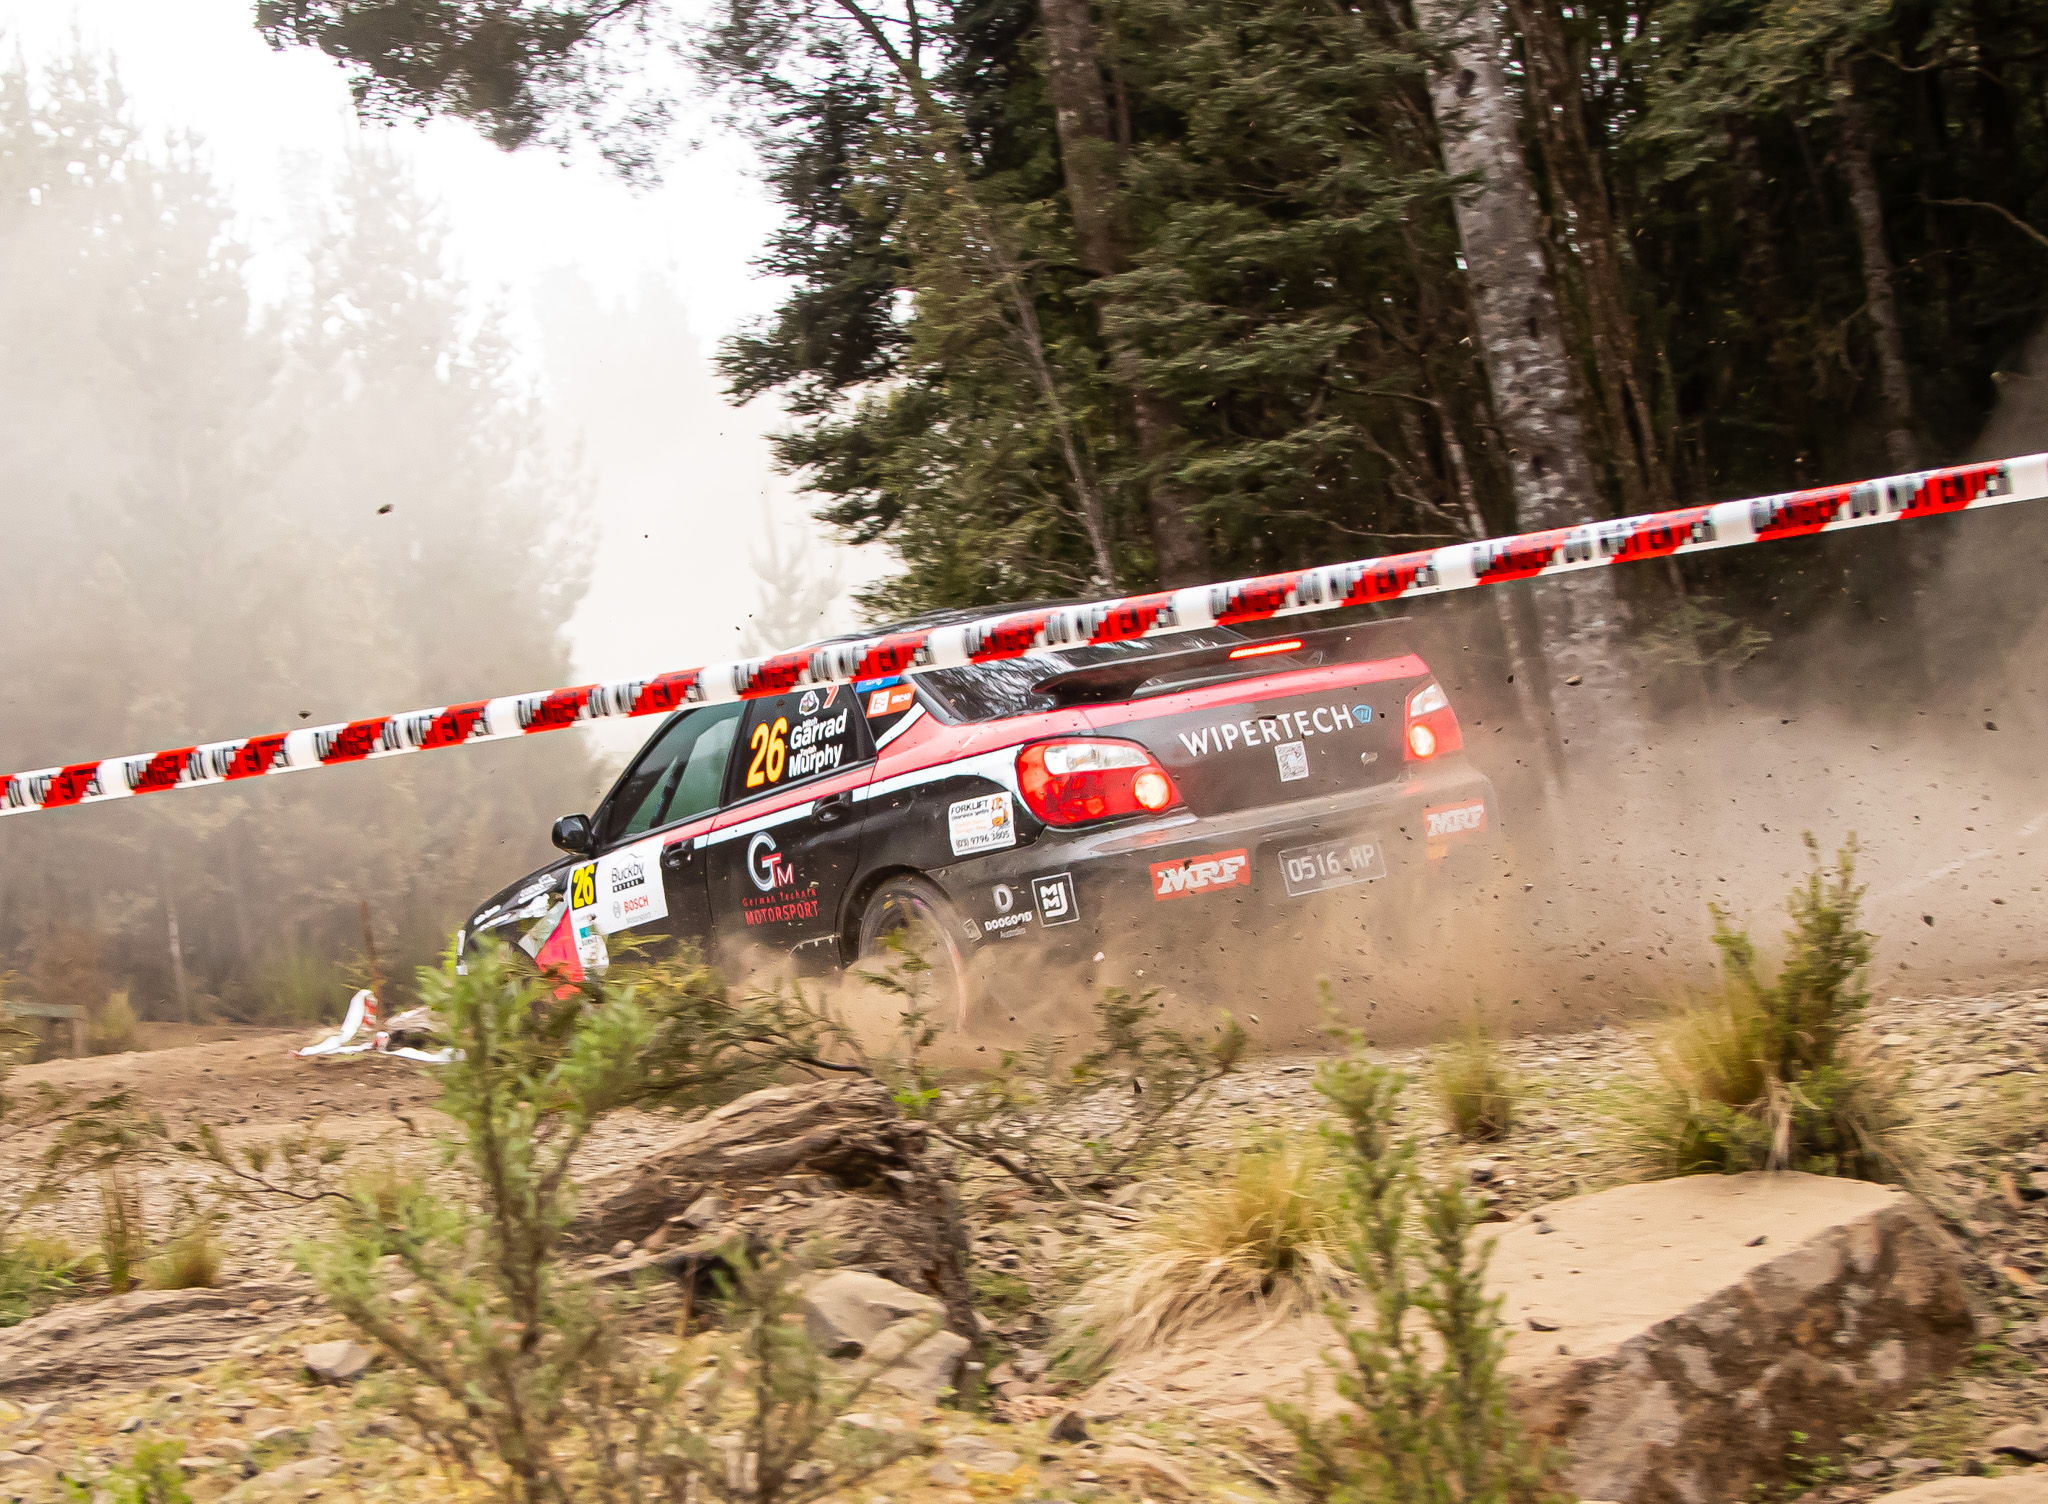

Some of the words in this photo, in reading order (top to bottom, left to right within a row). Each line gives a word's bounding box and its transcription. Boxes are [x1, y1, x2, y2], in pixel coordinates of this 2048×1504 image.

[790, 708, 848, 750] Garrad
[1178, 704, 1354, 757] WIPERTECH
[746, 716, 788, 788] 26
[788, 743, 843, 778] Murphy
[951, 799, 989, 815] FORKLIFT
[1428, 805, 1484, 837] MRF
[956, 838, 969, 848] (03)
[971, 834, 989, 845] 9796
[611, 861, 645, 884] Buckby
[1157, 855, 1246, 895] MRF
[1289, 851, 1340, 883] 0516
[573, 864, 595, 909] 26
[742, 895, 776, 907] German
[624, 895, 649, 913] BOSCH
[745, 900, 818, 925] MOTORSPORT
